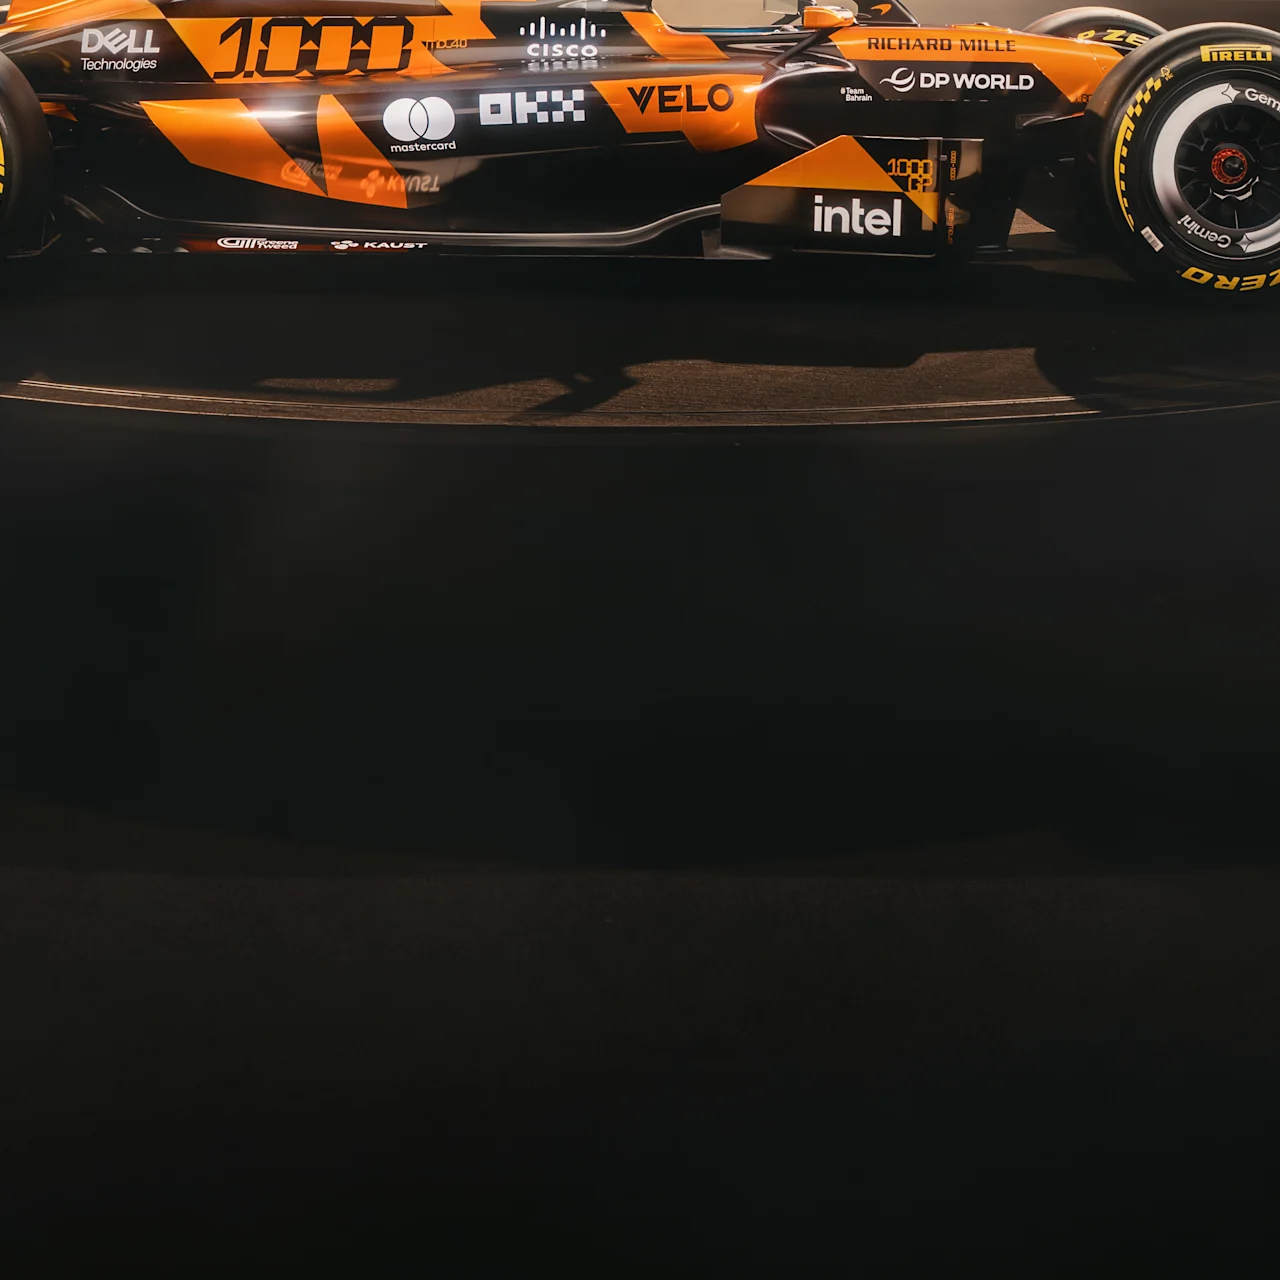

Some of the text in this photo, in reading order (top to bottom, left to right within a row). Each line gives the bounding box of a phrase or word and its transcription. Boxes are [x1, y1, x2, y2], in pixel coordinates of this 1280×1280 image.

[81, 27, 160, 55] DELL
[526, 43, 598, 57] CISCO
[867, 37, 1017, 52] RICHARD MILLE
[1200, 44, 1273, 63] PIRELLI
[80, 57, 158, 72] Technologies
[920, 72, 1034, 90] DP WORLD
[479, 89, 586, 125] OKX
[627, 83, 735, 115] VELO
[845, 94, 873, 102] Bahrain
[390, 140, 457, 153] mastercard
[813, 194, 902, 237] intel
[1177, 214, 1232, 249] Gemini
[363, 241, 428, 249] KAUST
